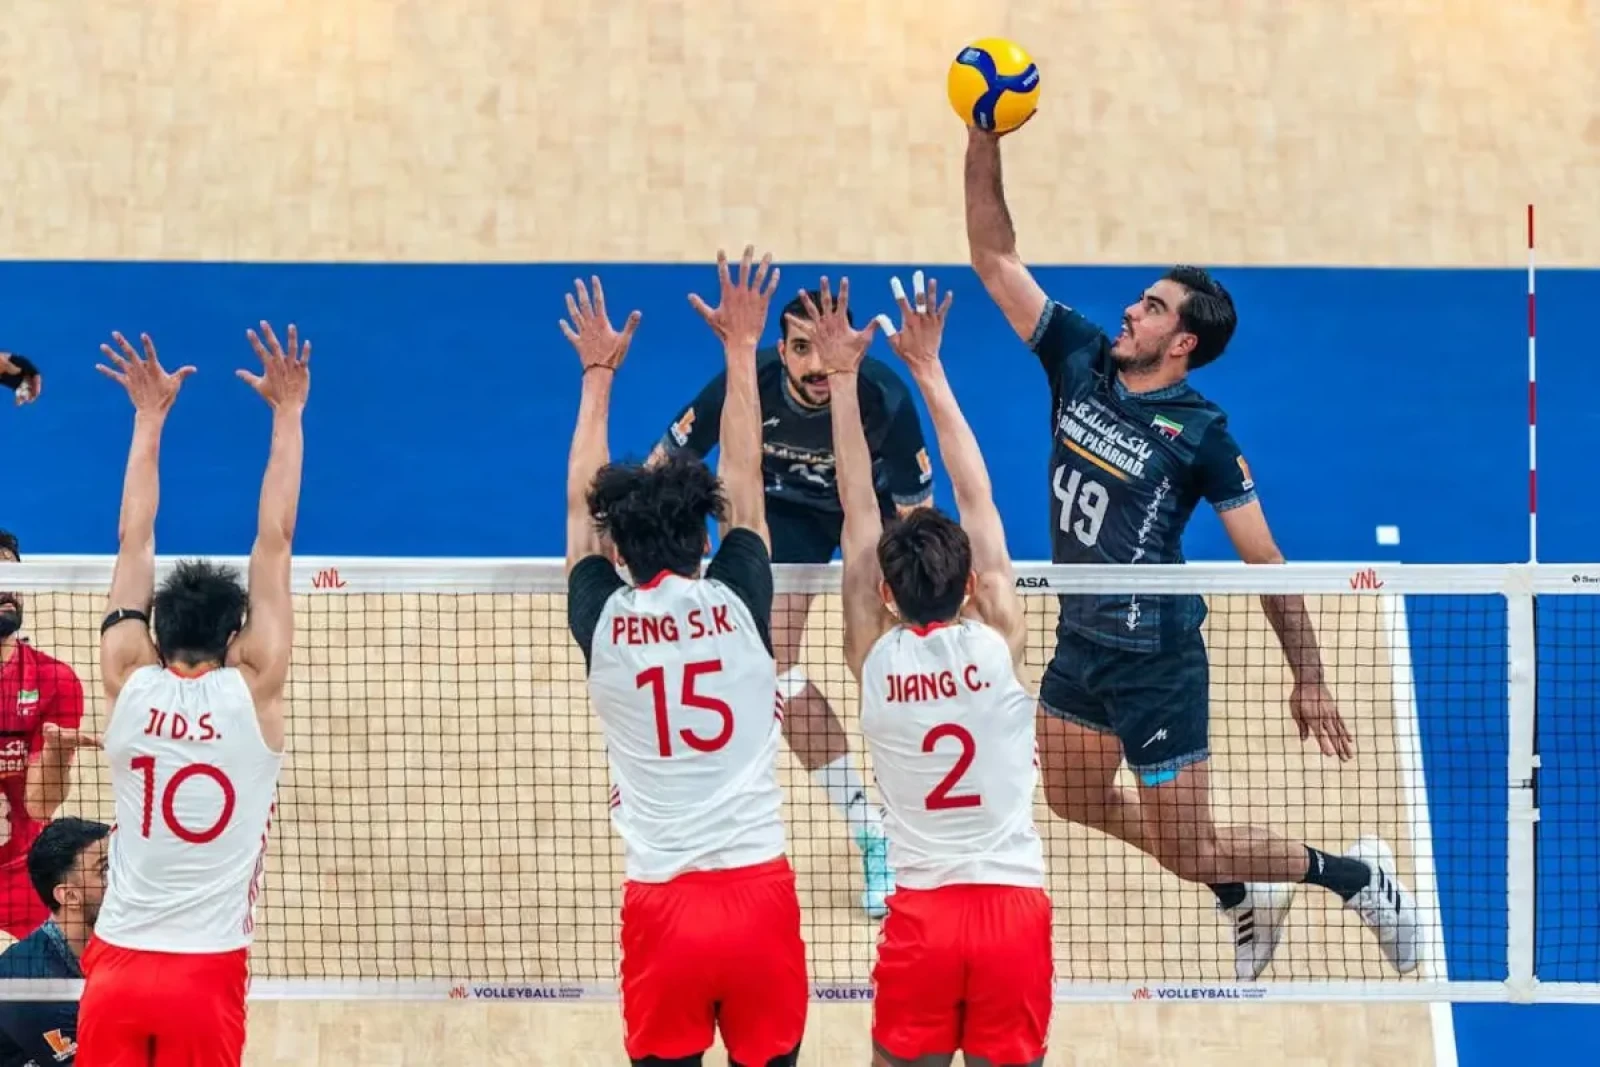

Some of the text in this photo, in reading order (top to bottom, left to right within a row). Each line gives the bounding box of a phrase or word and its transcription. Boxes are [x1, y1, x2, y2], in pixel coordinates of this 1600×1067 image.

[1060, 415, 1088, 443] BANK
[1083, 431, 1144, 477] PASARGAD
[1052, 463, 1109, 548] 49
[312, 567, 346, 588] VNL
[1349, 567, 1385, 589] VNL
[612, 604, 738, 645] PENG S.K.
[886, 665, 991, 703] JIANG C.
[144, 708, 222, 739] JI D.S.
[635, 659, 734, 758] 15
[921, 723, 982, 811] 2
[129, 755, 236, 844] 10
[474, 987, 556, 998] VOLLEYBALL
[1157, 988, 1240, 999] VOLLEYBALL
